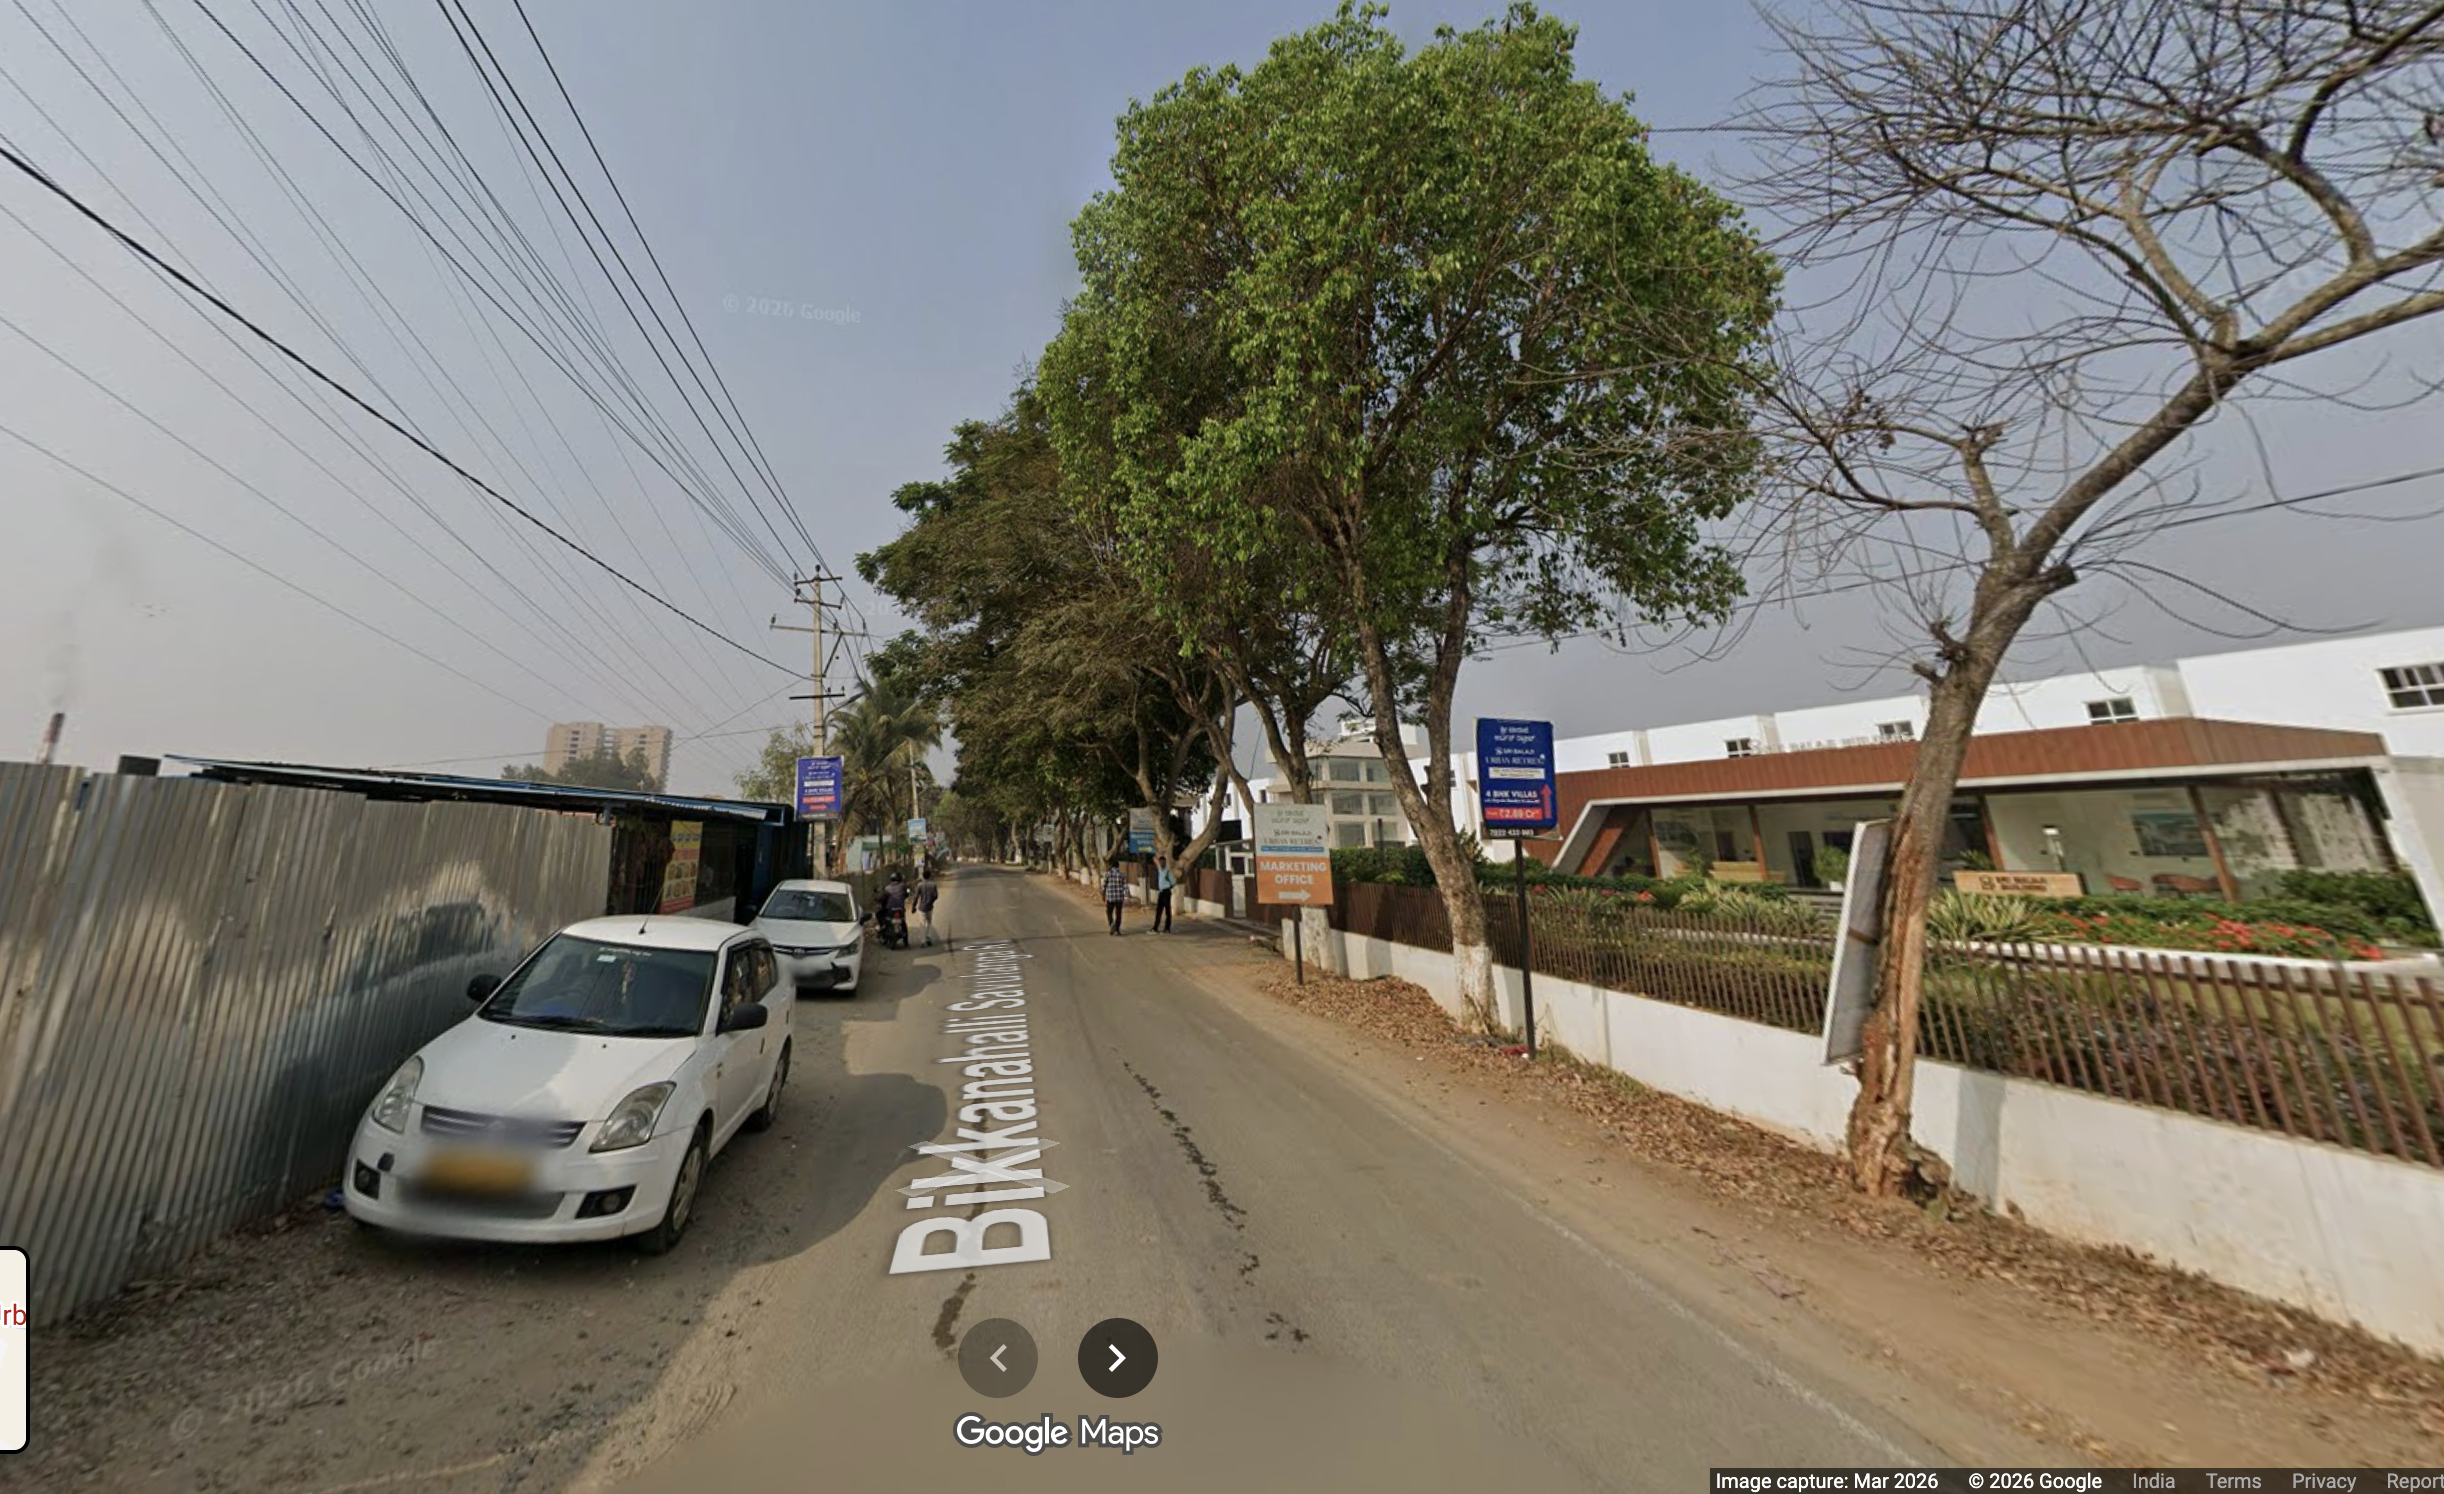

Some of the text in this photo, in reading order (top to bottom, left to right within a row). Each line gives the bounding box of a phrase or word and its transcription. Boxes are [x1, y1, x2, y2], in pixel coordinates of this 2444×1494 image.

[1511, 790, 1538, 798] VILLAS
[1260, 861, 1327, 872] MARKETING
[1274, 874, 1314, 885] OFFICE
